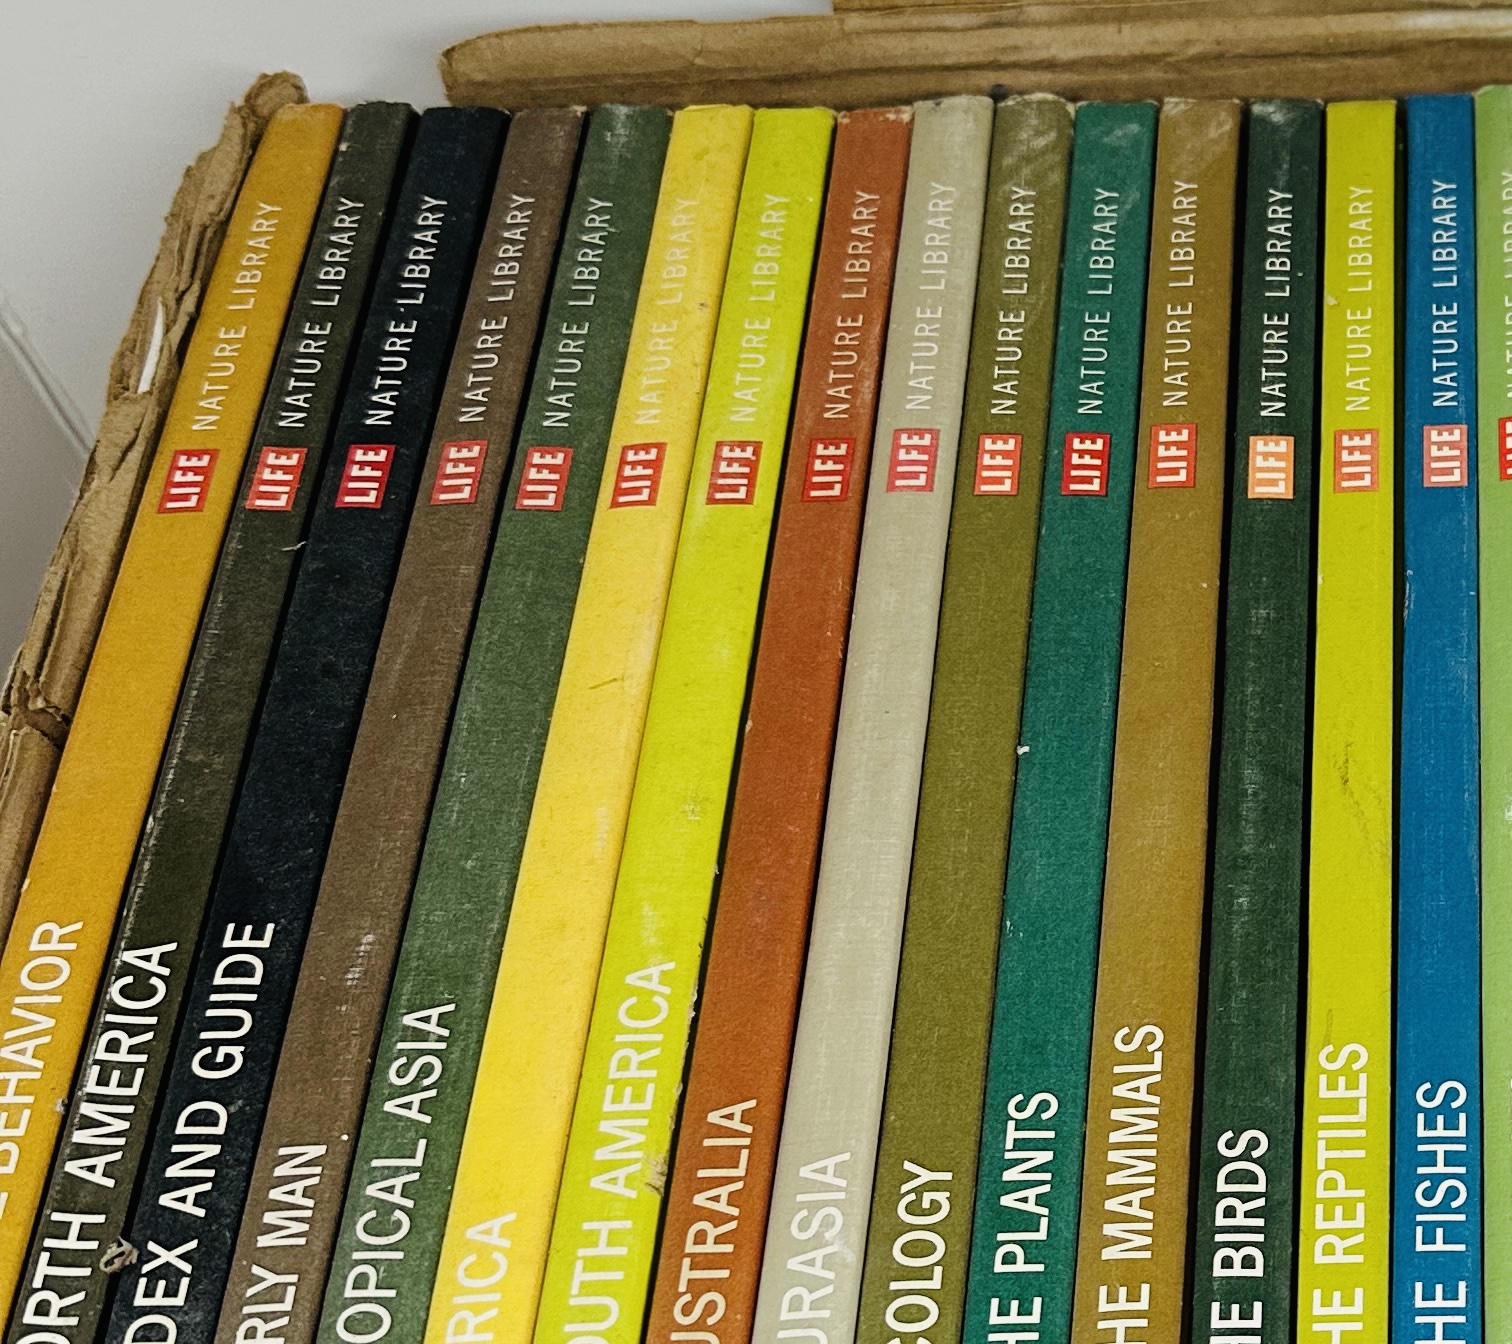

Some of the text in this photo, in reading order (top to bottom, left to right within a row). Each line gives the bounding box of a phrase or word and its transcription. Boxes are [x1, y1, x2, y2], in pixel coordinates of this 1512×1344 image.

[166, 201, 284, 510] LIFE NATURE LIBRARY
[256, 197, 366, 508] LIFE NATURE LIBRARY
[345, 195, 449, 507] LIFE NATURE LIBRARY
[439, 194, 536, 504] LIFE NATURE LIBRARY
[526, 197, 614, 508] LIFE NATURE LIBRARY
[619, 197, 699, 505] LIFE NATURE LIBRARY
[713, 193, 791, 504] LIFE NATURE LIBRARY
[811, 190, 882, 499] LIFE NATURE LIBRARY
[894, 181, 958, 490] LIFE NATURE LIBRARY
[980, 185, 1038, 494] LIFE NATURE LIBRARY
[1069, 187, 1121, 494] LIFE NATURE LIBRARY
[1156, 179, 1199, 485] LIFE NATURE LIBRARY
[1254, 188, 1294, 495] LIFE NATURE LIBRARY
[1342, 185, 1375, 490] LIFE NATURE LIBRARY
[1429, 179, 1462, 485] LIFE NATURE LIBRARY
[64, 941, 179, 1188] AMERICA
[192, 921, 275, 1081] GUIDE
[389, 1002, 456, 1125] ASIA
[591, 960, 676, 1200] AMERICA
[1101, 1024, 1166, 1260] MAMMALS
[1316, 1043, 1369, 1264] REPTILES
[159, 1099, 229, 1218] AND
[257, 1144, 328, 1247] MAN
[994, 1091, 1060, 1274] PLANTS
[1212, 1128, 1269, 1278] BIRDS
[1415, 1080, 1468, 1253] FISHES
